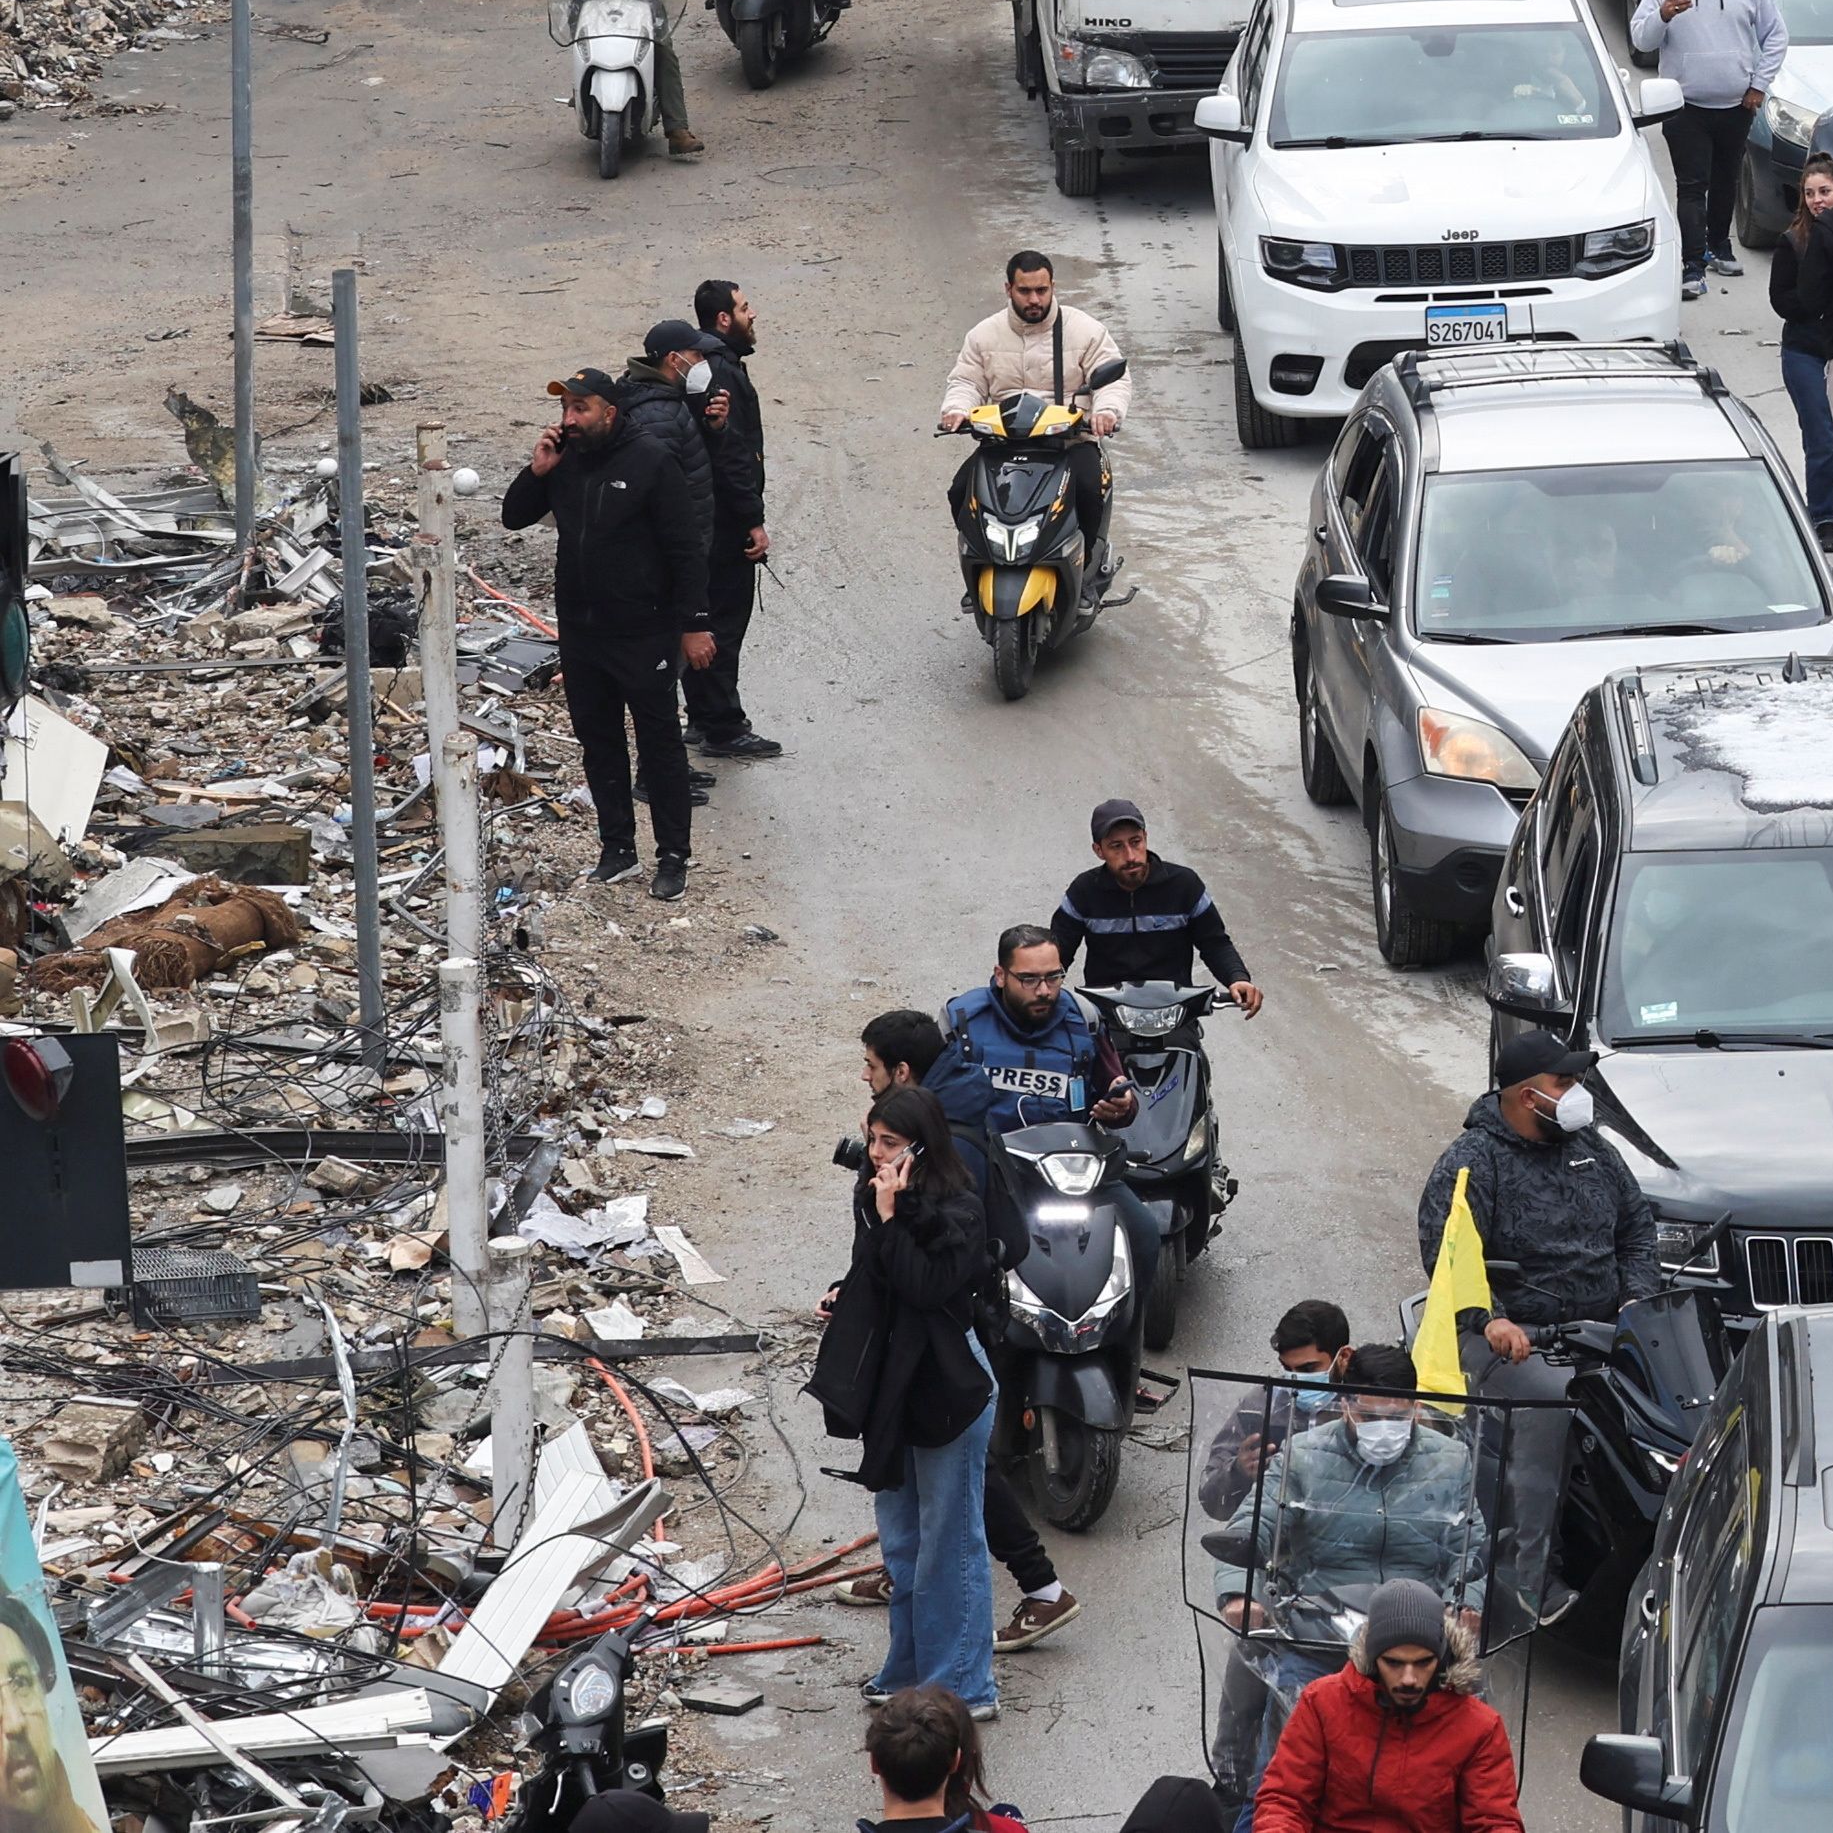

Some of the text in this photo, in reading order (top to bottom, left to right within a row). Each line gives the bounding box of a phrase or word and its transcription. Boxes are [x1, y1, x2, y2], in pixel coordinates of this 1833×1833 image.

[1084, 17, 1133, 28] HINO
[1441, 229, 1479, 242] Jeep
[1429, 320, 1502, 343] S267041
[988, 1067, 1060, 1093] PRESS
